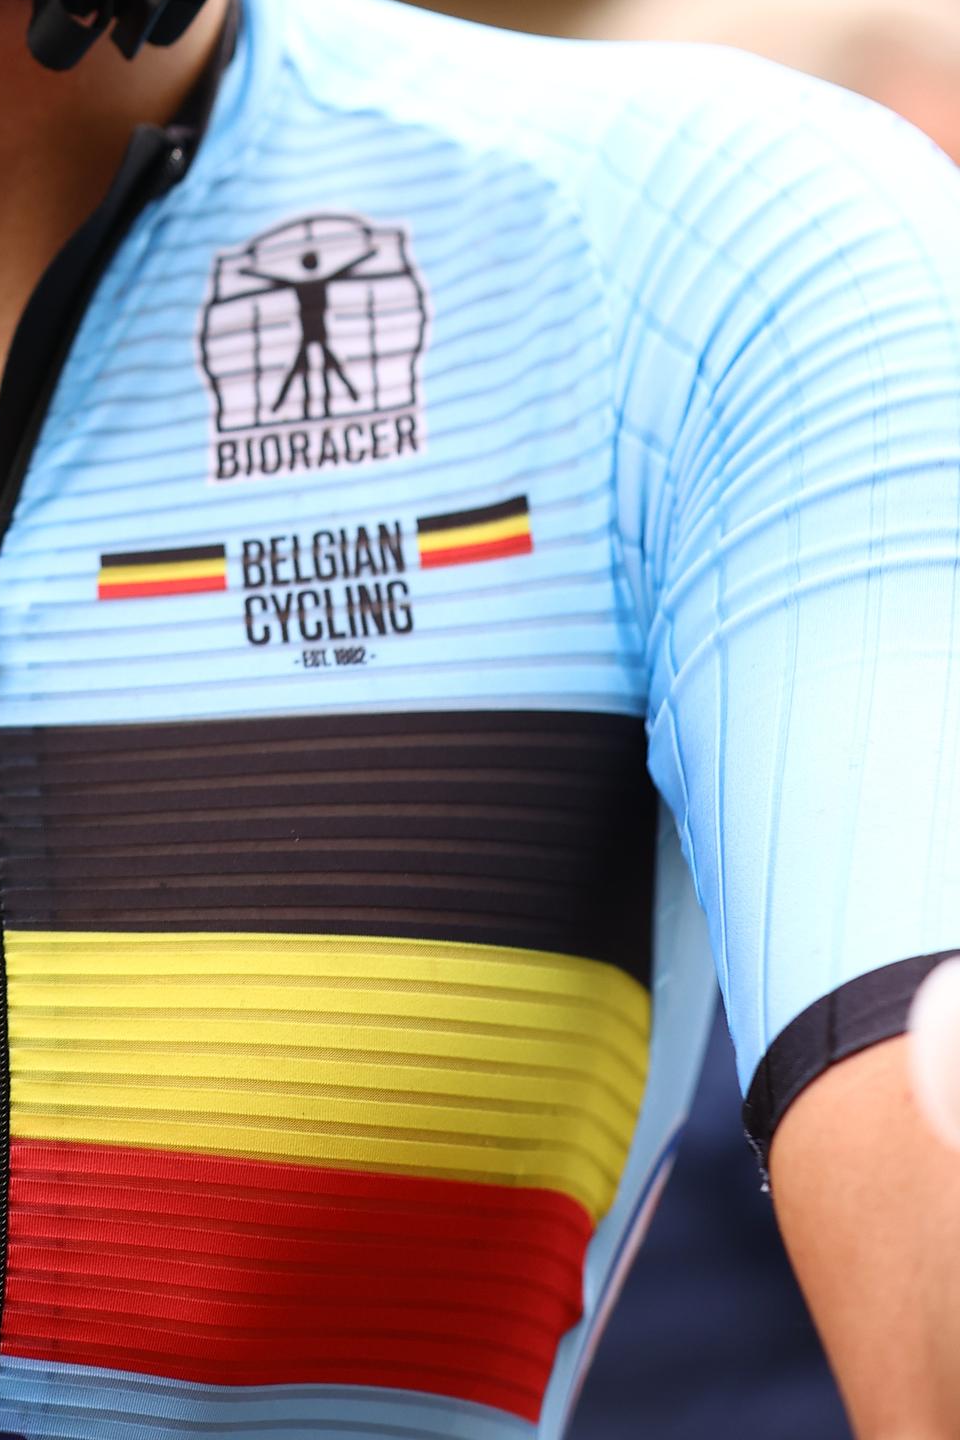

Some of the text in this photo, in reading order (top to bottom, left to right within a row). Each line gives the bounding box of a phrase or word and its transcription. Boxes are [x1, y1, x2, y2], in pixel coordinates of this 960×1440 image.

[216, 414, 419, 480] BIORACER
[241, 519, 406, 590] BELGIAN
[243, 580, 414, 646] CYCLING
